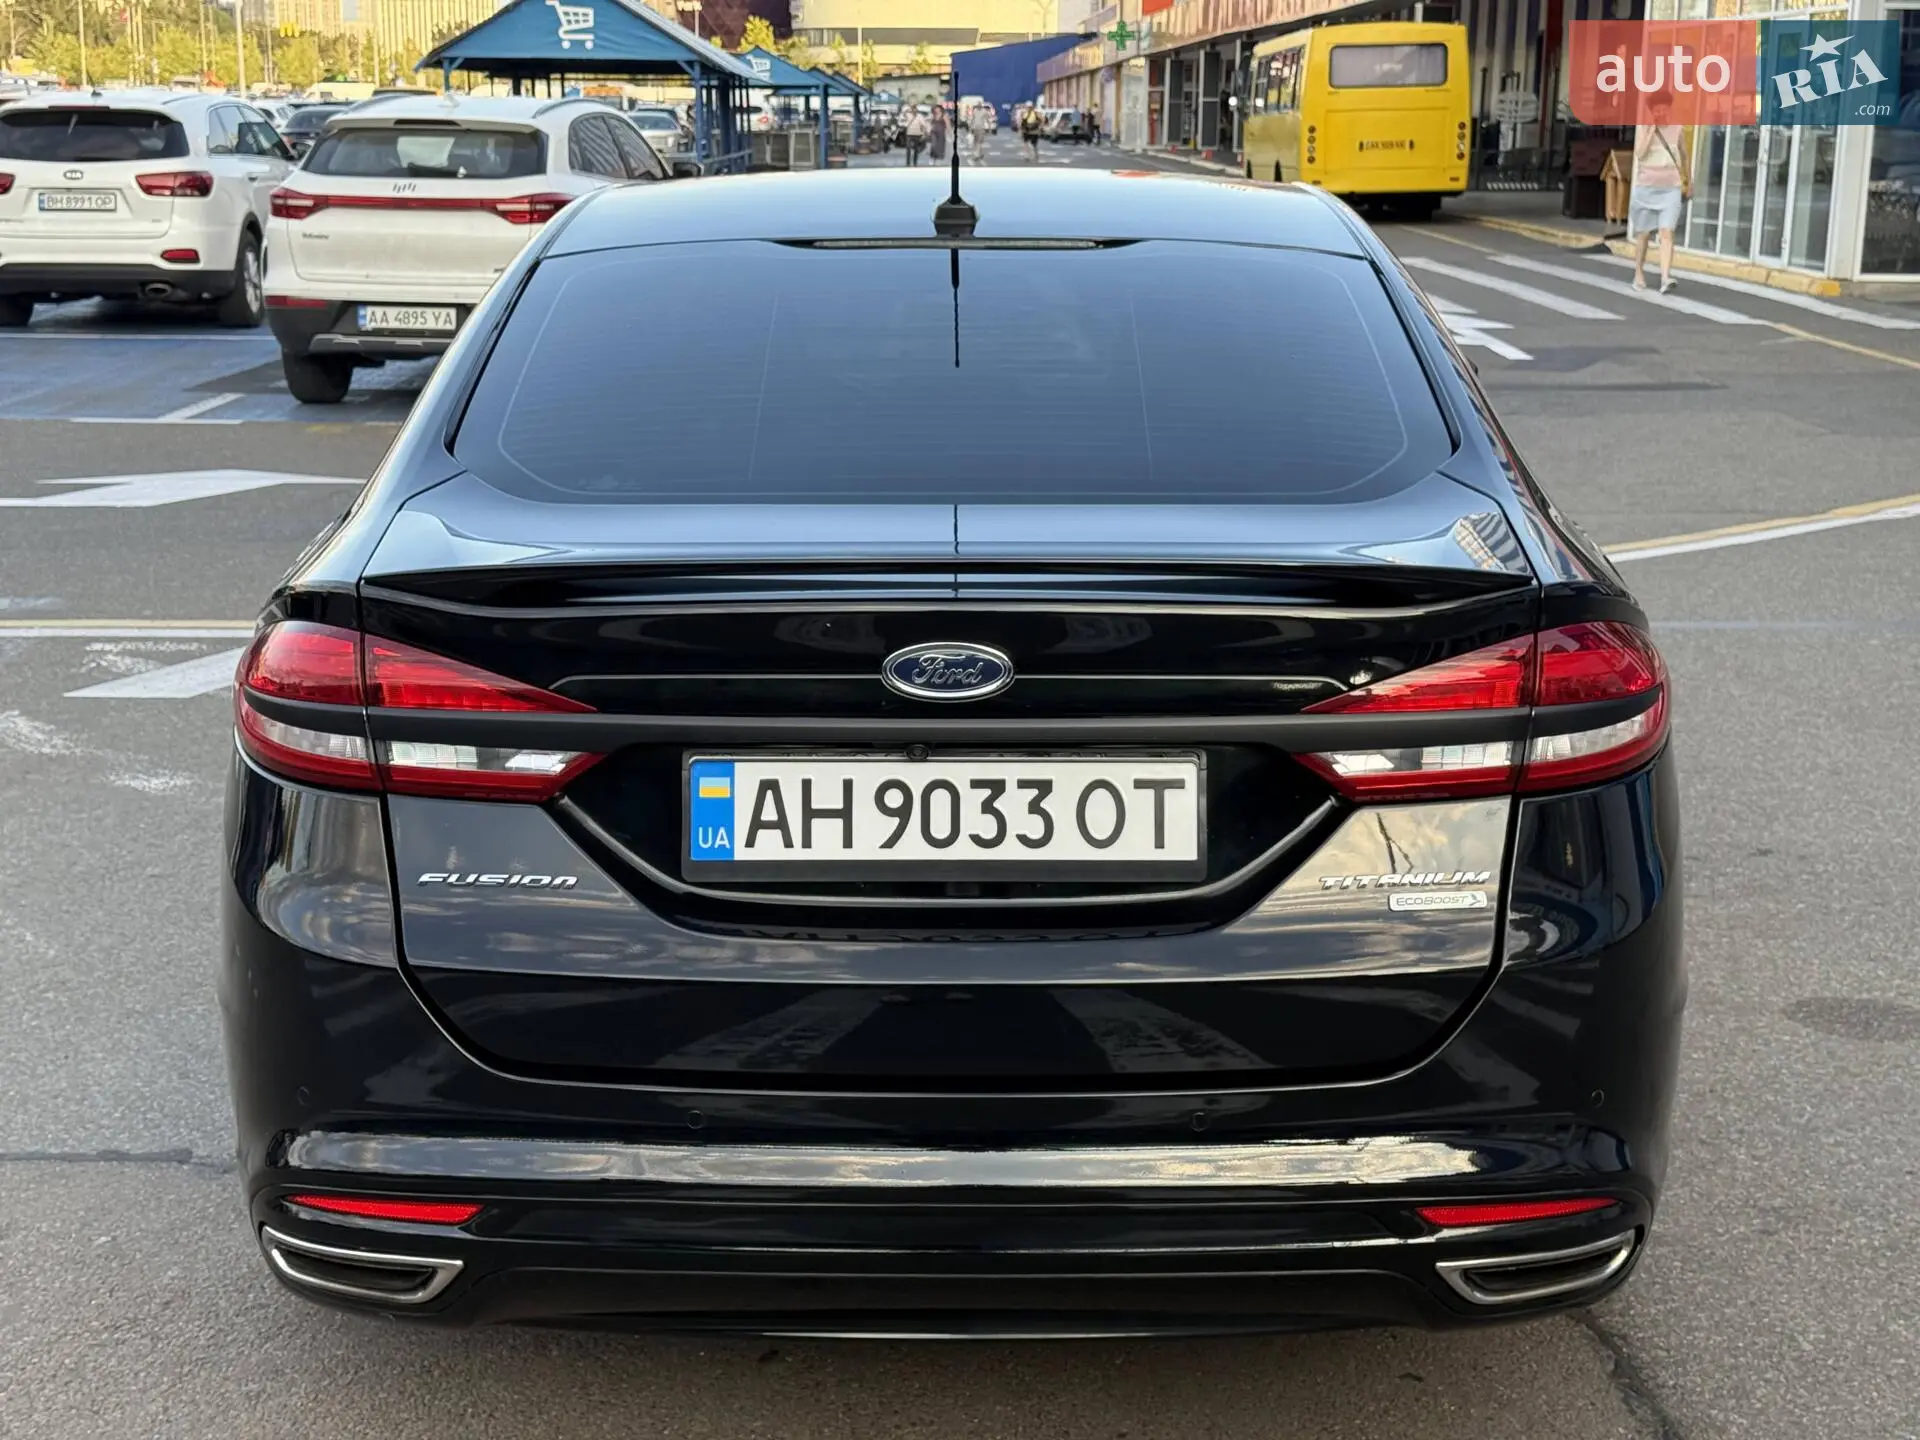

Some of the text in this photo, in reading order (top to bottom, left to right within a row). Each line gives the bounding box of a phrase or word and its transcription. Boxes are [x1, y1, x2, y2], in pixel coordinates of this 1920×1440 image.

[368, 310, 453, 326] AA 4895 YA
[911, 653, 983, 685] Ford
[744, 778, 1186, 850] AH 9033 OT
[698, 826, 730, 849] UA
[417, 872, 578, 890] FUSION
[1319, 871, 1491, 890] TITANIUM
